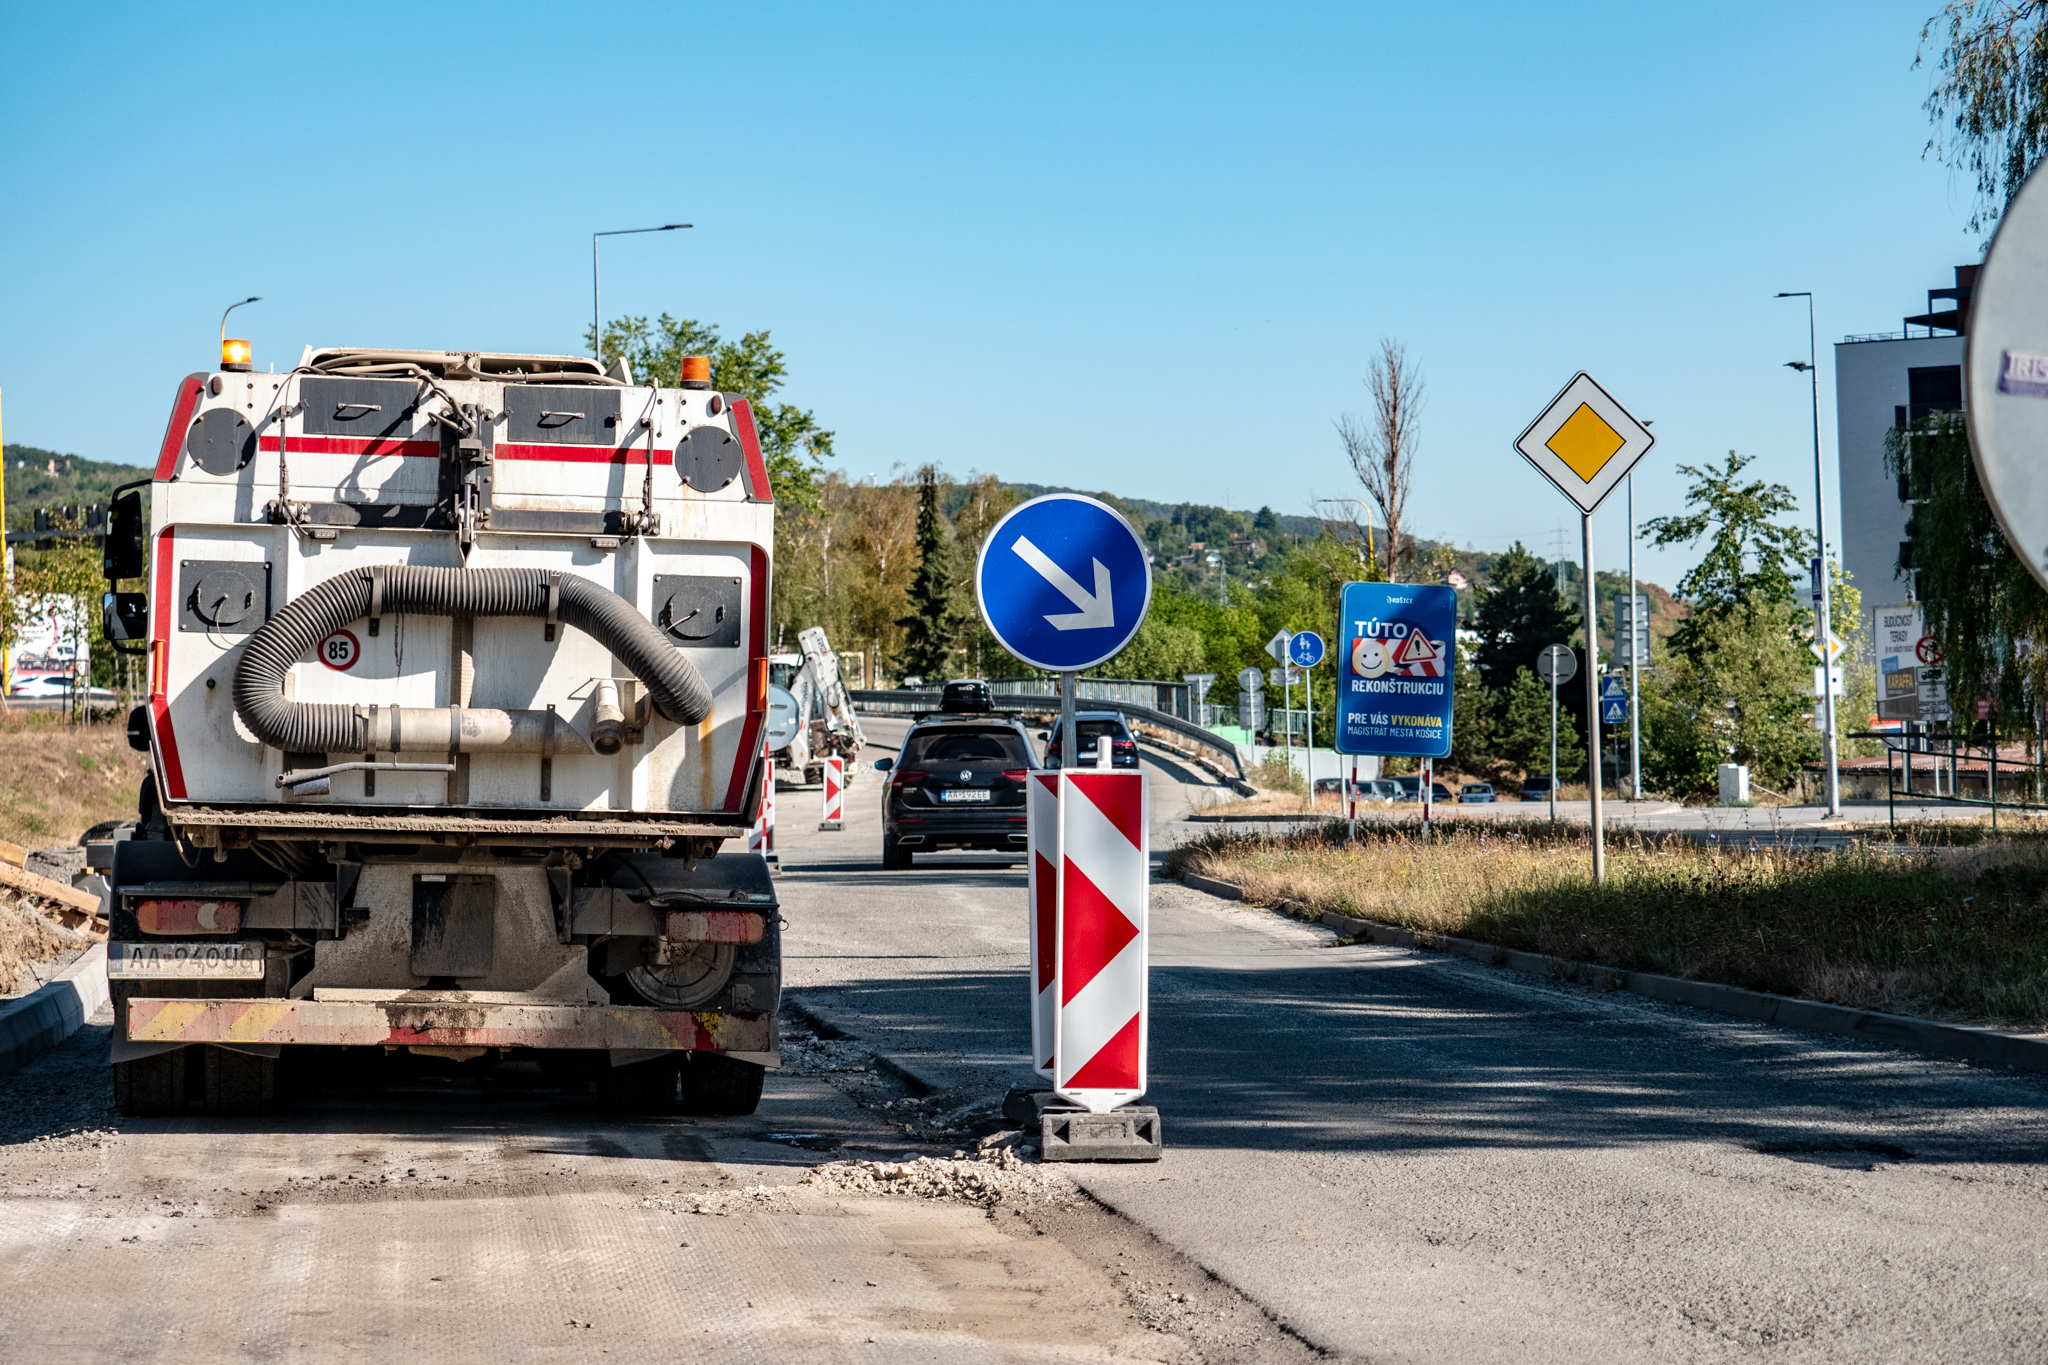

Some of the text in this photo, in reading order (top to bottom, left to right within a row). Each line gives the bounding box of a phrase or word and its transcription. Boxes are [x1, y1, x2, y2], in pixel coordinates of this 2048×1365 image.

[1354, 617, 1408, 639] TÚTO
[329, 641, 349, 660] 85
[1351, 678, 1444, 696] REKONŠTRUKCIU
[1887, 674, 1914, 689] KARAFFA
[1347, 711, 1442, 728] PRE VÁS VYKONÁVA
[1347, 726, 1442, 739] MAGISTRÁT MESTA KOŠICE
[111, 961, 122, 969] SK
[130, 947, 161, 969] AA
